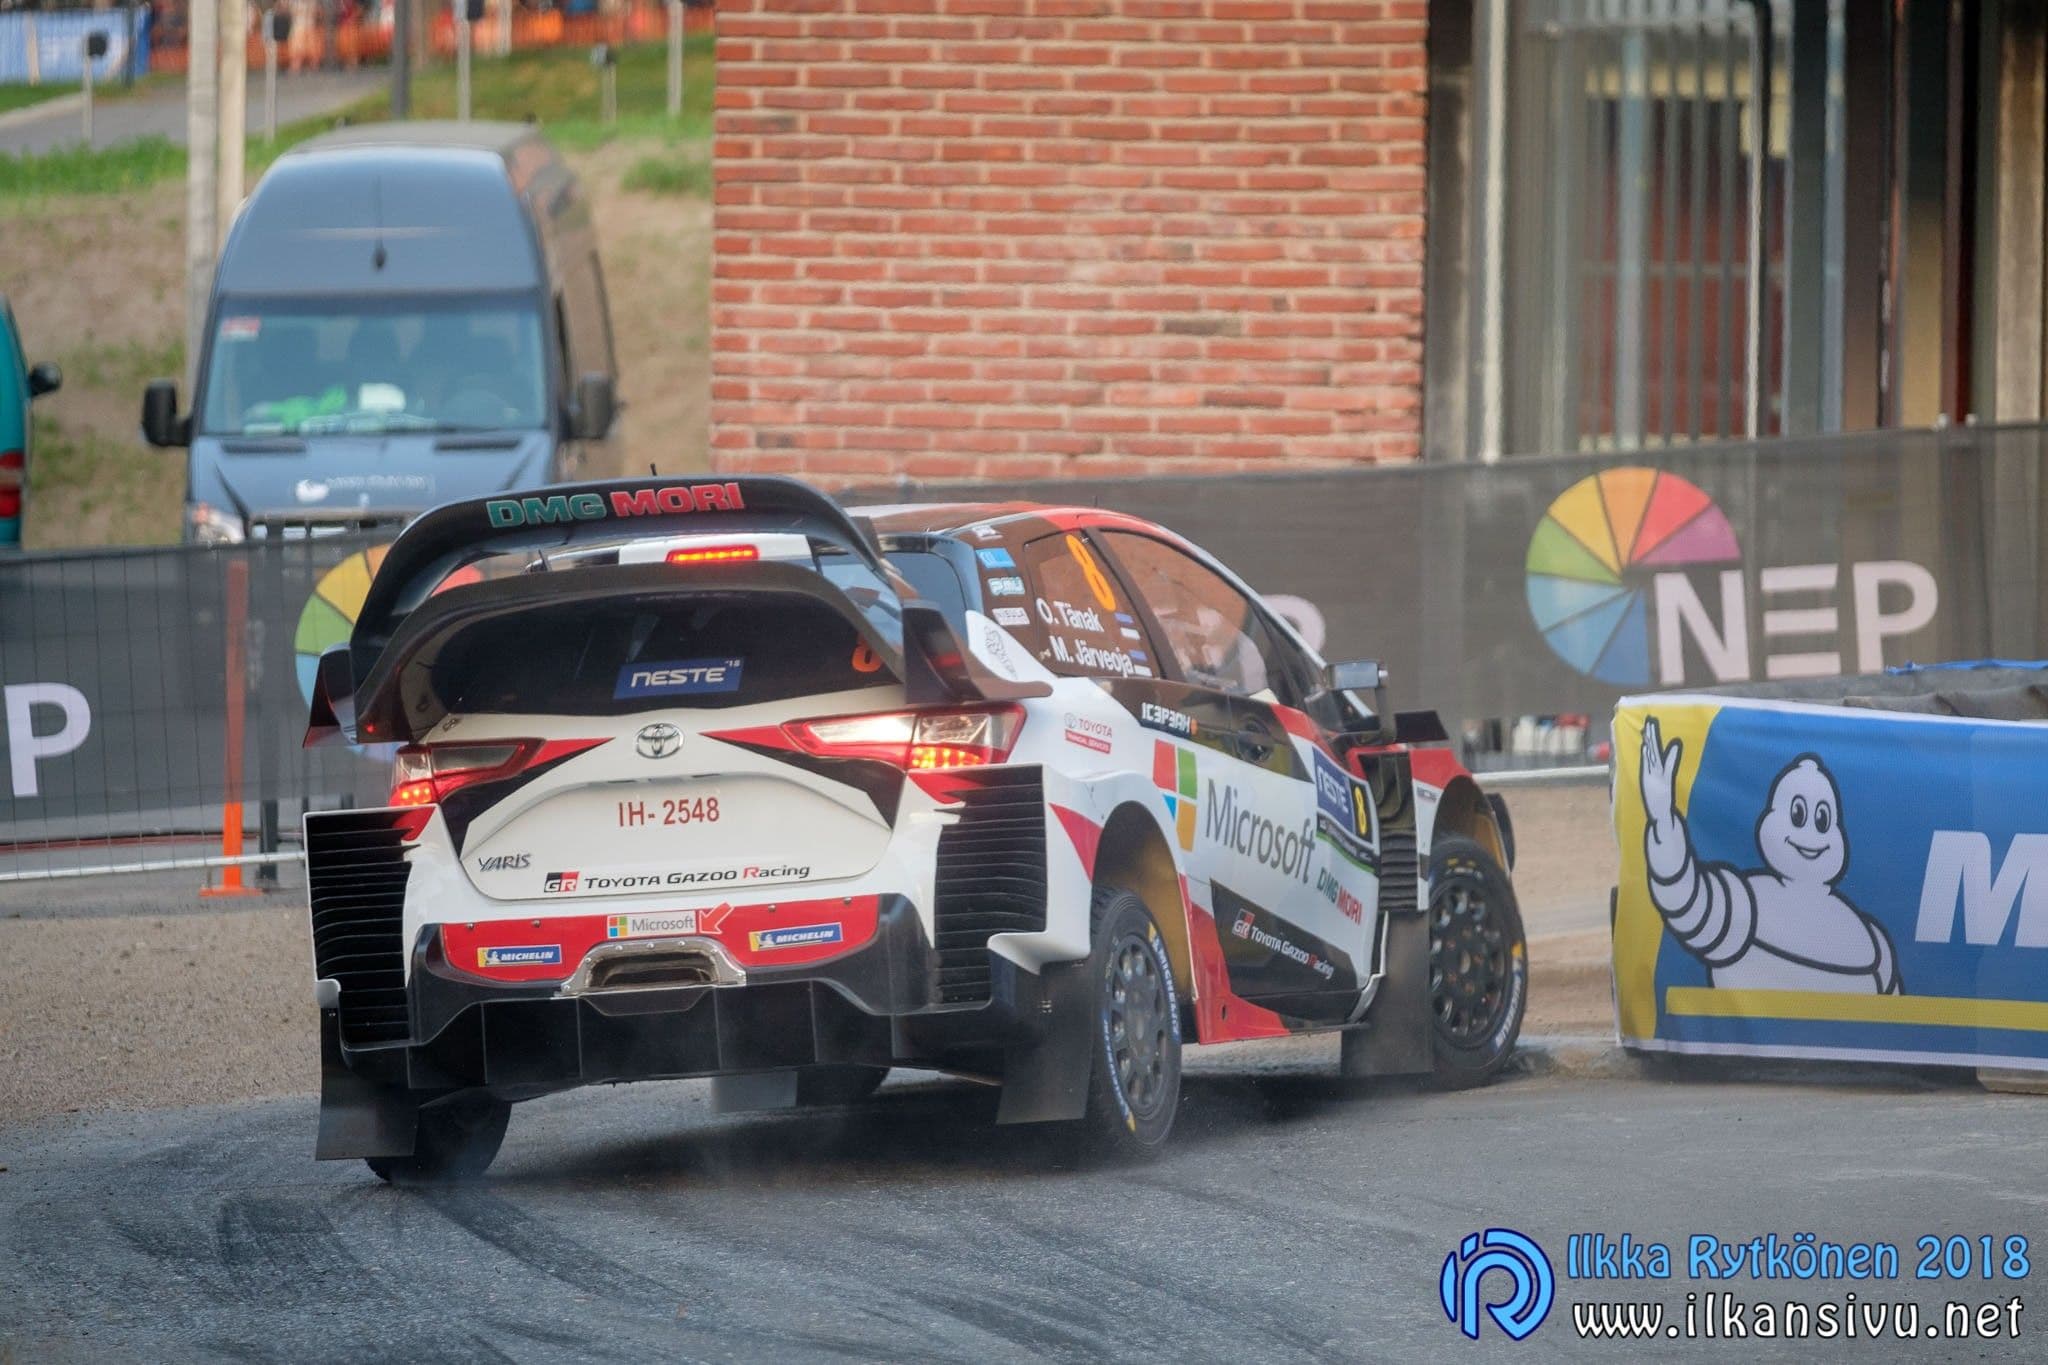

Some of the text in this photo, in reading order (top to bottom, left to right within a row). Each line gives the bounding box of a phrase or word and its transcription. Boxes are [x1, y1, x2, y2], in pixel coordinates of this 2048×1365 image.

[486, 482, 745, 528] DMG MORI
[1066, 534, 1116, 611] 8
[1036, 598, 1058, 624] O.
[1053, 601, 1104, 632] Tänak
[1654, 560, 1938, 685] NEP
[631, 666, 726, 688] NESTE
[1050, 636, 1074, 663] M.
[1075, 639, 1134, 677] Järveoja
[1078, 718, 1113, 738] TOYOTA
[1317, 765, 1368, 836] NESTE 8
[1206, 778, 1315, 884] Microsoft
[544, 865, 811, 893] GR TOYOTA GAZOO Racing
[1316, 867, 1363, 926] DMG MORI
[632, 912, 694, 932] Microsoft
[776, 930, 835, 944] MICHELIN
[501, 951, 554, 961] MICHELIN
[1250, 925, 1281, 952] TOYOTA
[1281, 941, 1309, 965] GAZOO
[1308, 955, 1335, 980] Racing
